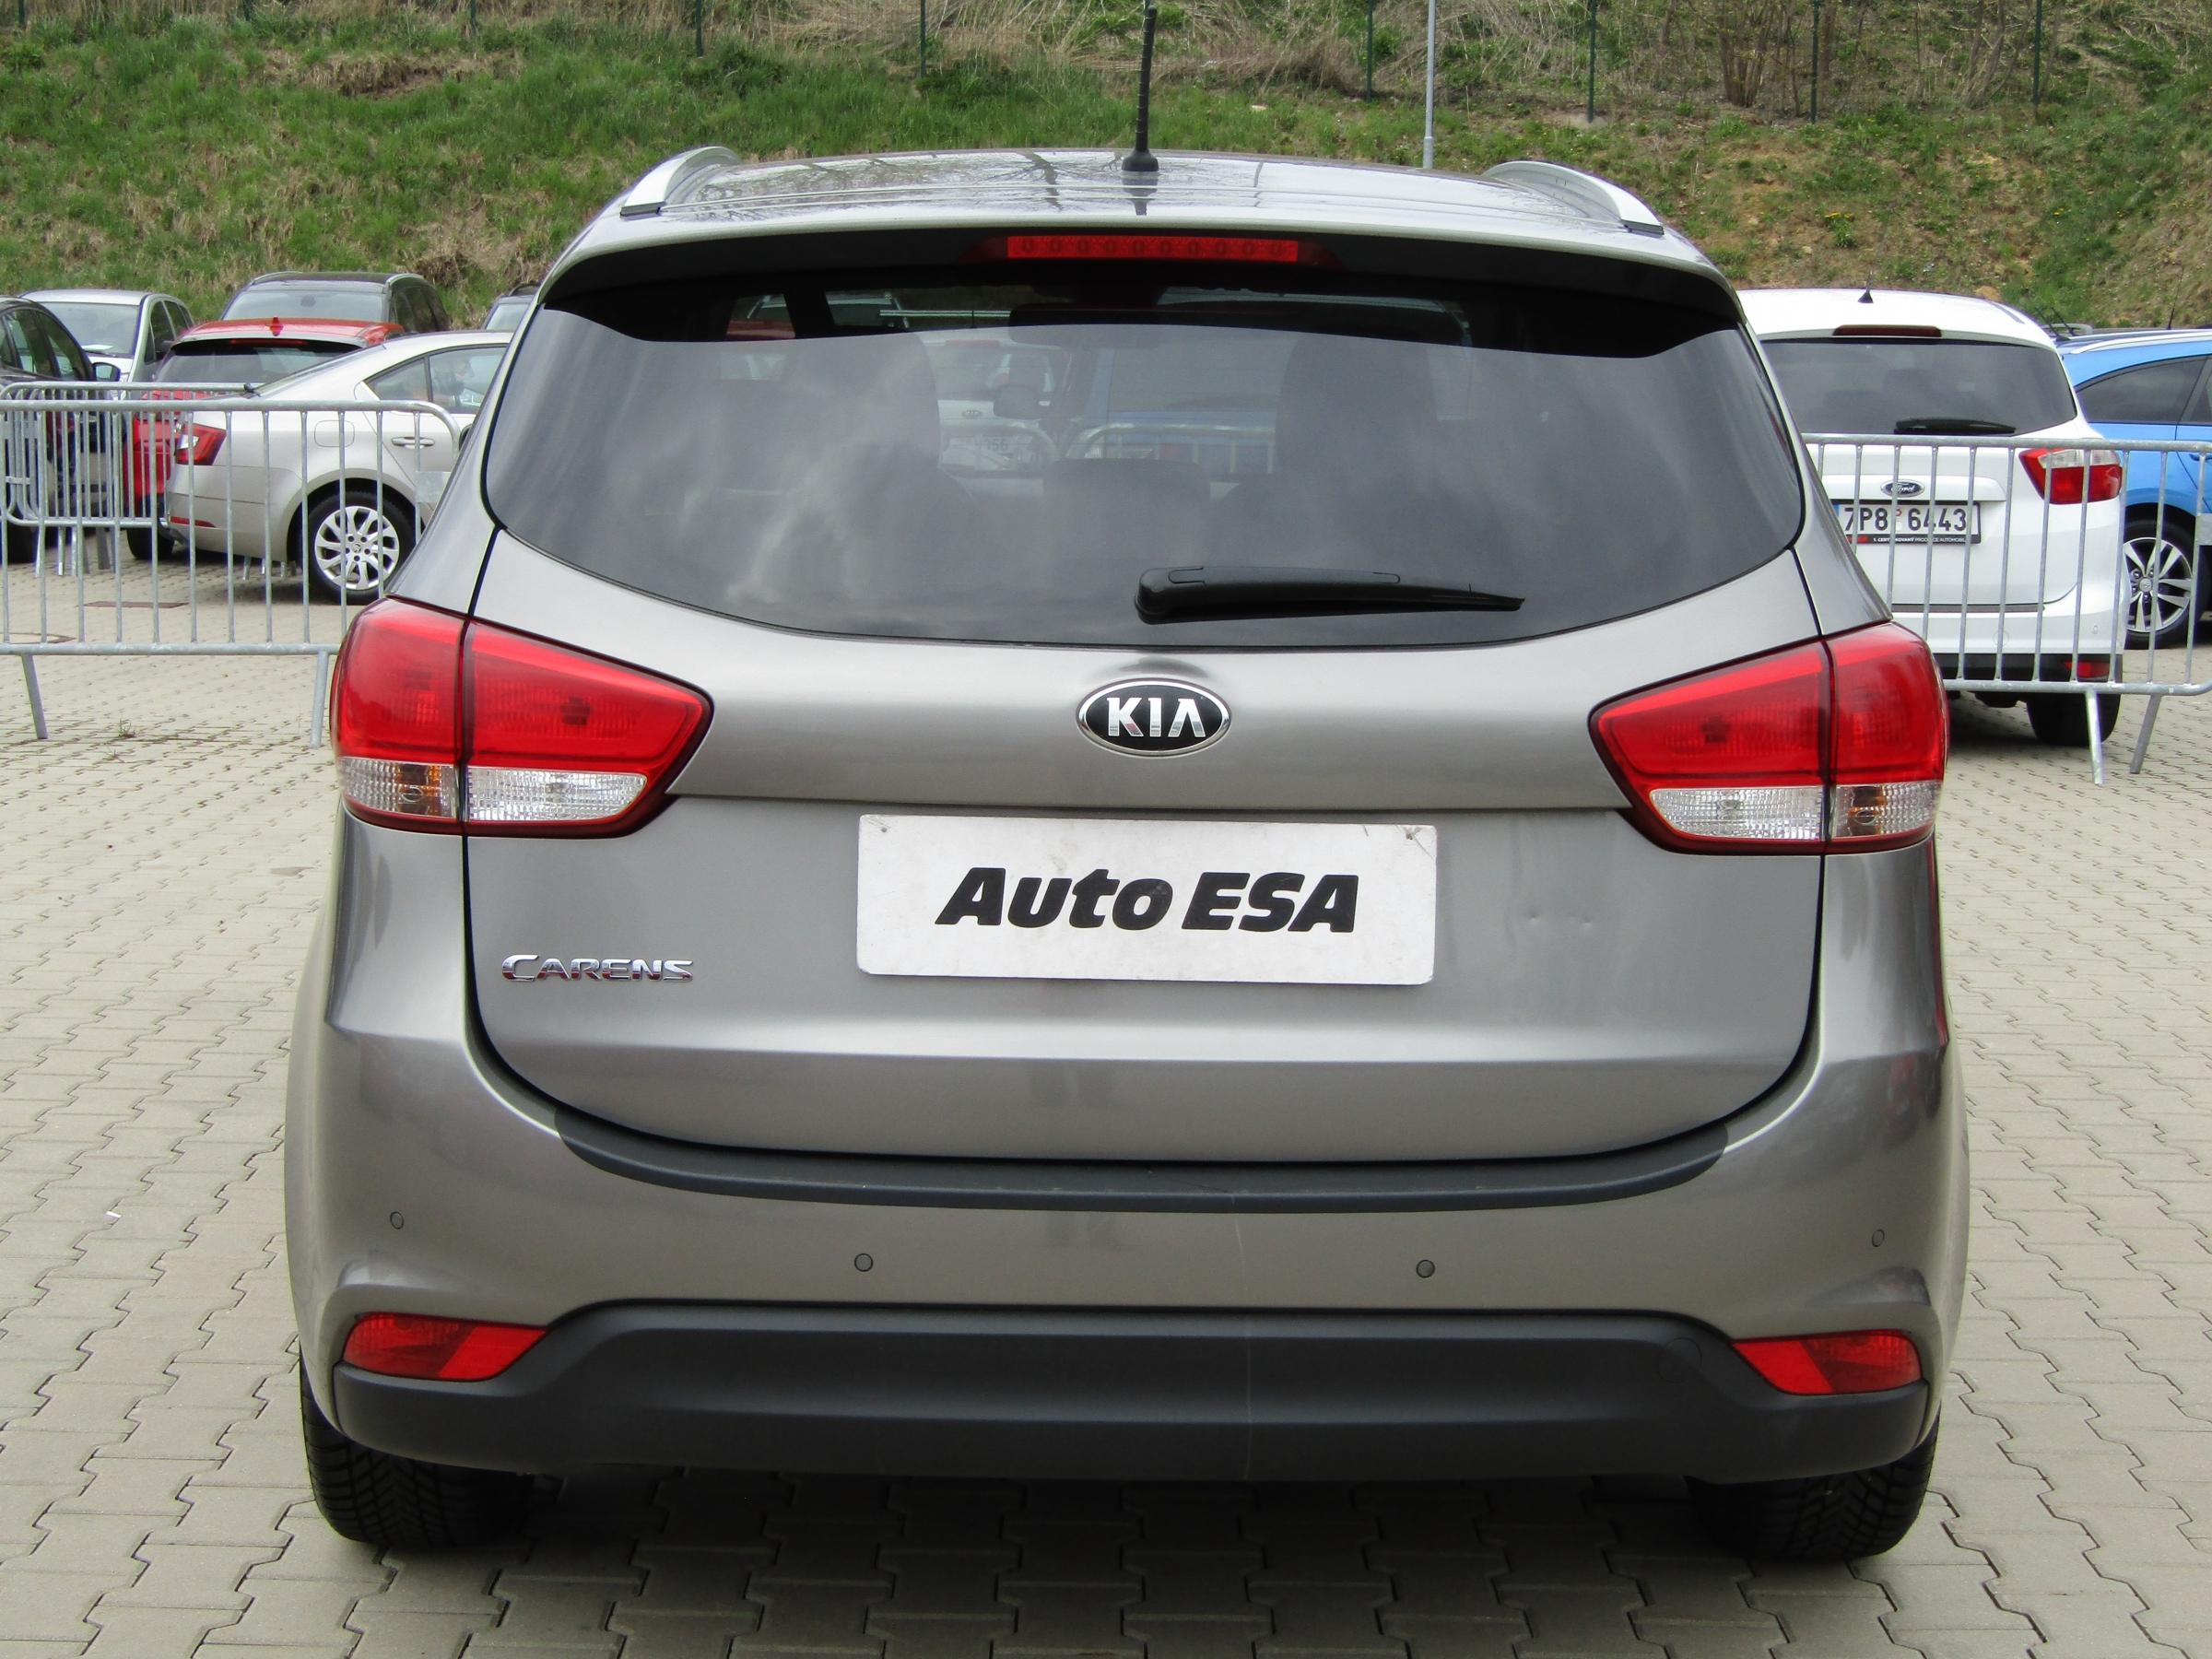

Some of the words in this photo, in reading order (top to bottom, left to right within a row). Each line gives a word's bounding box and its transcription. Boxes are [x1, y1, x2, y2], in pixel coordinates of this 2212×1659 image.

[1844, 507, 1888, 531] 7P8
[1908, 508, 1967, 531] 6443
[1106, 697, 1206, 738] KIA
[934, 866, 1173, 931] Auto
[1181, 871, 1359, 933] ESA
[501, 954, 693, 982] CARENS
